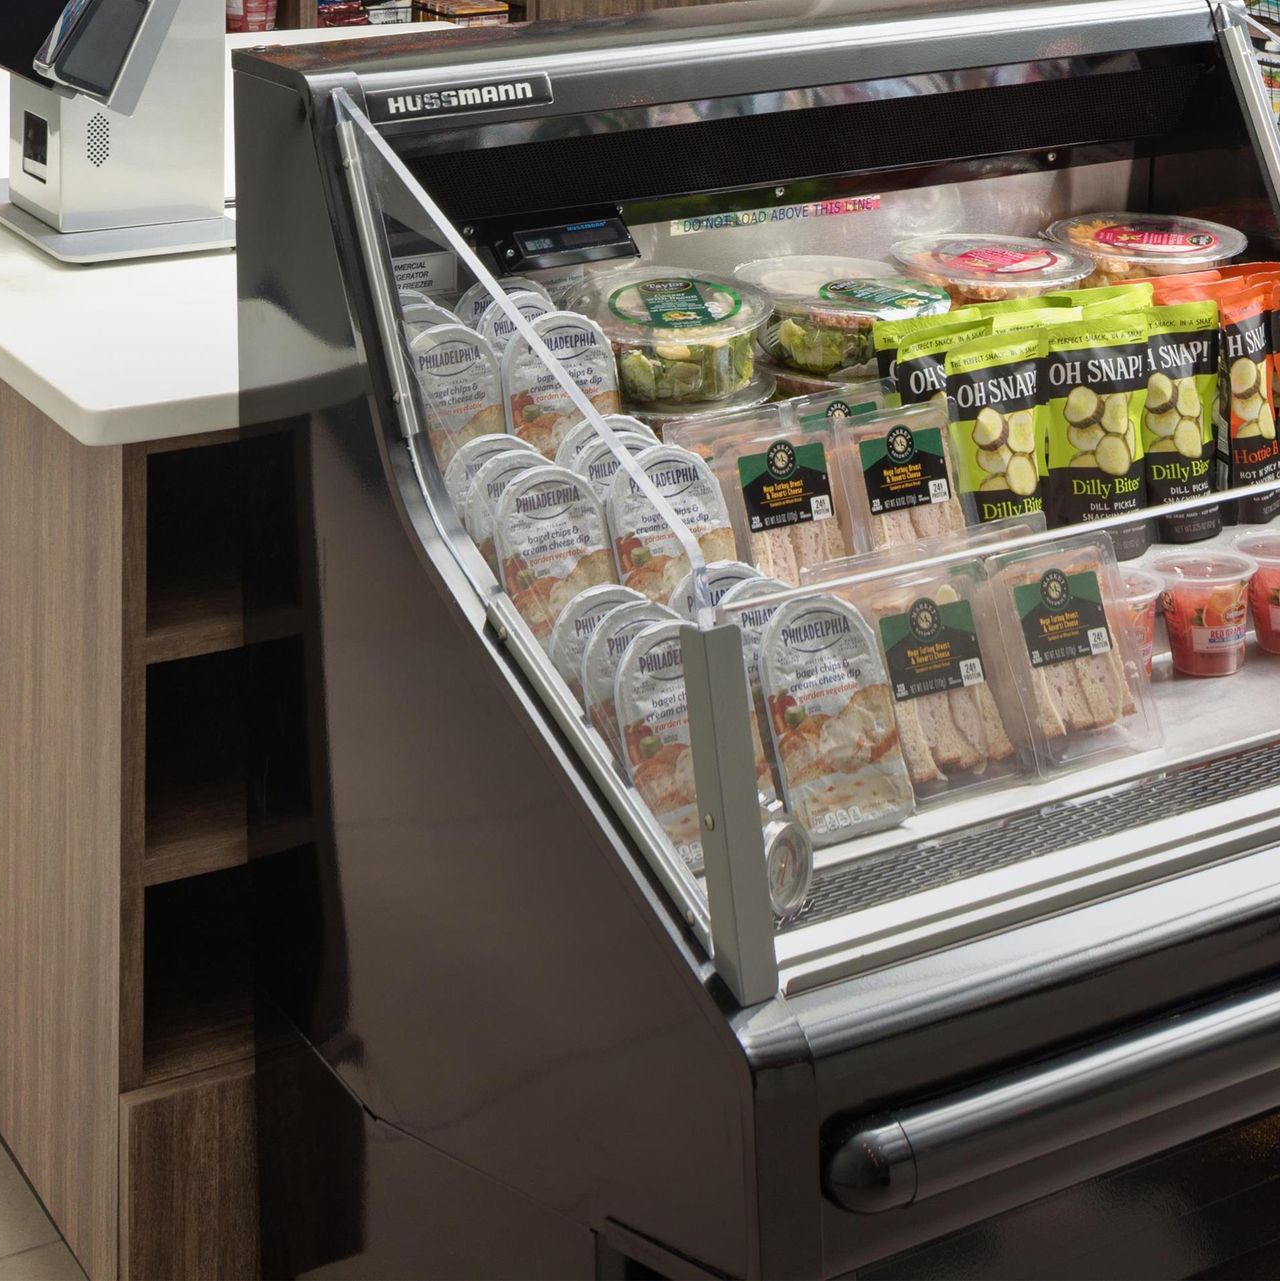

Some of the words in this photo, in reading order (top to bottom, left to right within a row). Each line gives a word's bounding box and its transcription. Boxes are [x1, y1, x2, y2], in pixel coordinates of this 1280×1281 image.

[387, 81, 534, 114] HUSSMANN
[683, 219, 701, 232] DO
[705, 214, 731, 229] NOT
[735, 210, 767, 225] LOAD
[771, 206, 809, 220] ABOVE
[813, 201, 841, 216] THIS
[845, 197, 873, 212] LINE
[403, 280, 434, 290] FREEZER
[1195, 317, 1213, 328] SNAP
[1056, 335, 1083, 345] PERFECT
[1085, 332, 1108, 344] SNACK,
[1127, 329, 1143, 339] SNAP
[418, 345, 481, 370] PHILADELPHIA
[951, 359, 961, 368] THE
[963, 354, 985, 366] PERFECT
[1159, 340, 1209, 370] SNAP!
[1049, 361, 1082, 386] OH
[1086, 354, 1143, 384] SNAP!
[450, 384, 472, 397] chips
[530, 384, 553, 394] cream
[590, 375, 603, 387] dip
[910, 368, 937, 395] OH
[957, 383, 986, 409] OH
[987, 369, 1038, 404] SNAP!
[448, 395, 472, 406] cheese
[473, 391, 486, 402] dip
[888, 428, 911, 444] MARKET
[769, 444, 793, 460] MARKET
[1233, 443, 1271, 465] Hottie
[1152, 463, 1190, 482] Dilly
[1240, 470, 1257, 479] HOT
[931, 491, 948, 499] PROTEIN
[1073, 478, 1113, 499] Dilly
[1115, 476, 1140, 494] Bites
[1170, 485, 1190, 495] DILL
[515, 485, 580, 513] PHILADELPHIA
[1090, 502, 1110, 511] DILL
[1113, 498, 1137, 510] PICKLE
[814, 507, 830, 515] PROTEIN
[983, 502, 1022, 520] Dilly
[635, 523, 659, 535] cream
[696, 513, 710, 526] dip
[527, 530, 553, 545] bagel
[551, 527, 572, 542] chips
[522, 544, 547, 557] cream
[549, 539, 575, 552] cheese
[576, 534, 590, 549] dip
[528, 554, 555, 567] garden
[781, 616, 851, 647] PHILADELPHIA
[1210, 629, 1222, 639] RED
[795, 664, 819, 679] bagel
[819, 661, 840, 676] chips
[790, 680, 818, 693] cream
[819, 674, 846, 687] cheese
[847, 670, 862, 685] dip
[652, 695, 677, 710] bagel
[798, 690, 825, 705] garden
[825, 682, 859, 699] vegetable
[645, 708, 673, 722] cream
[654, 720, 681, 734] garden
